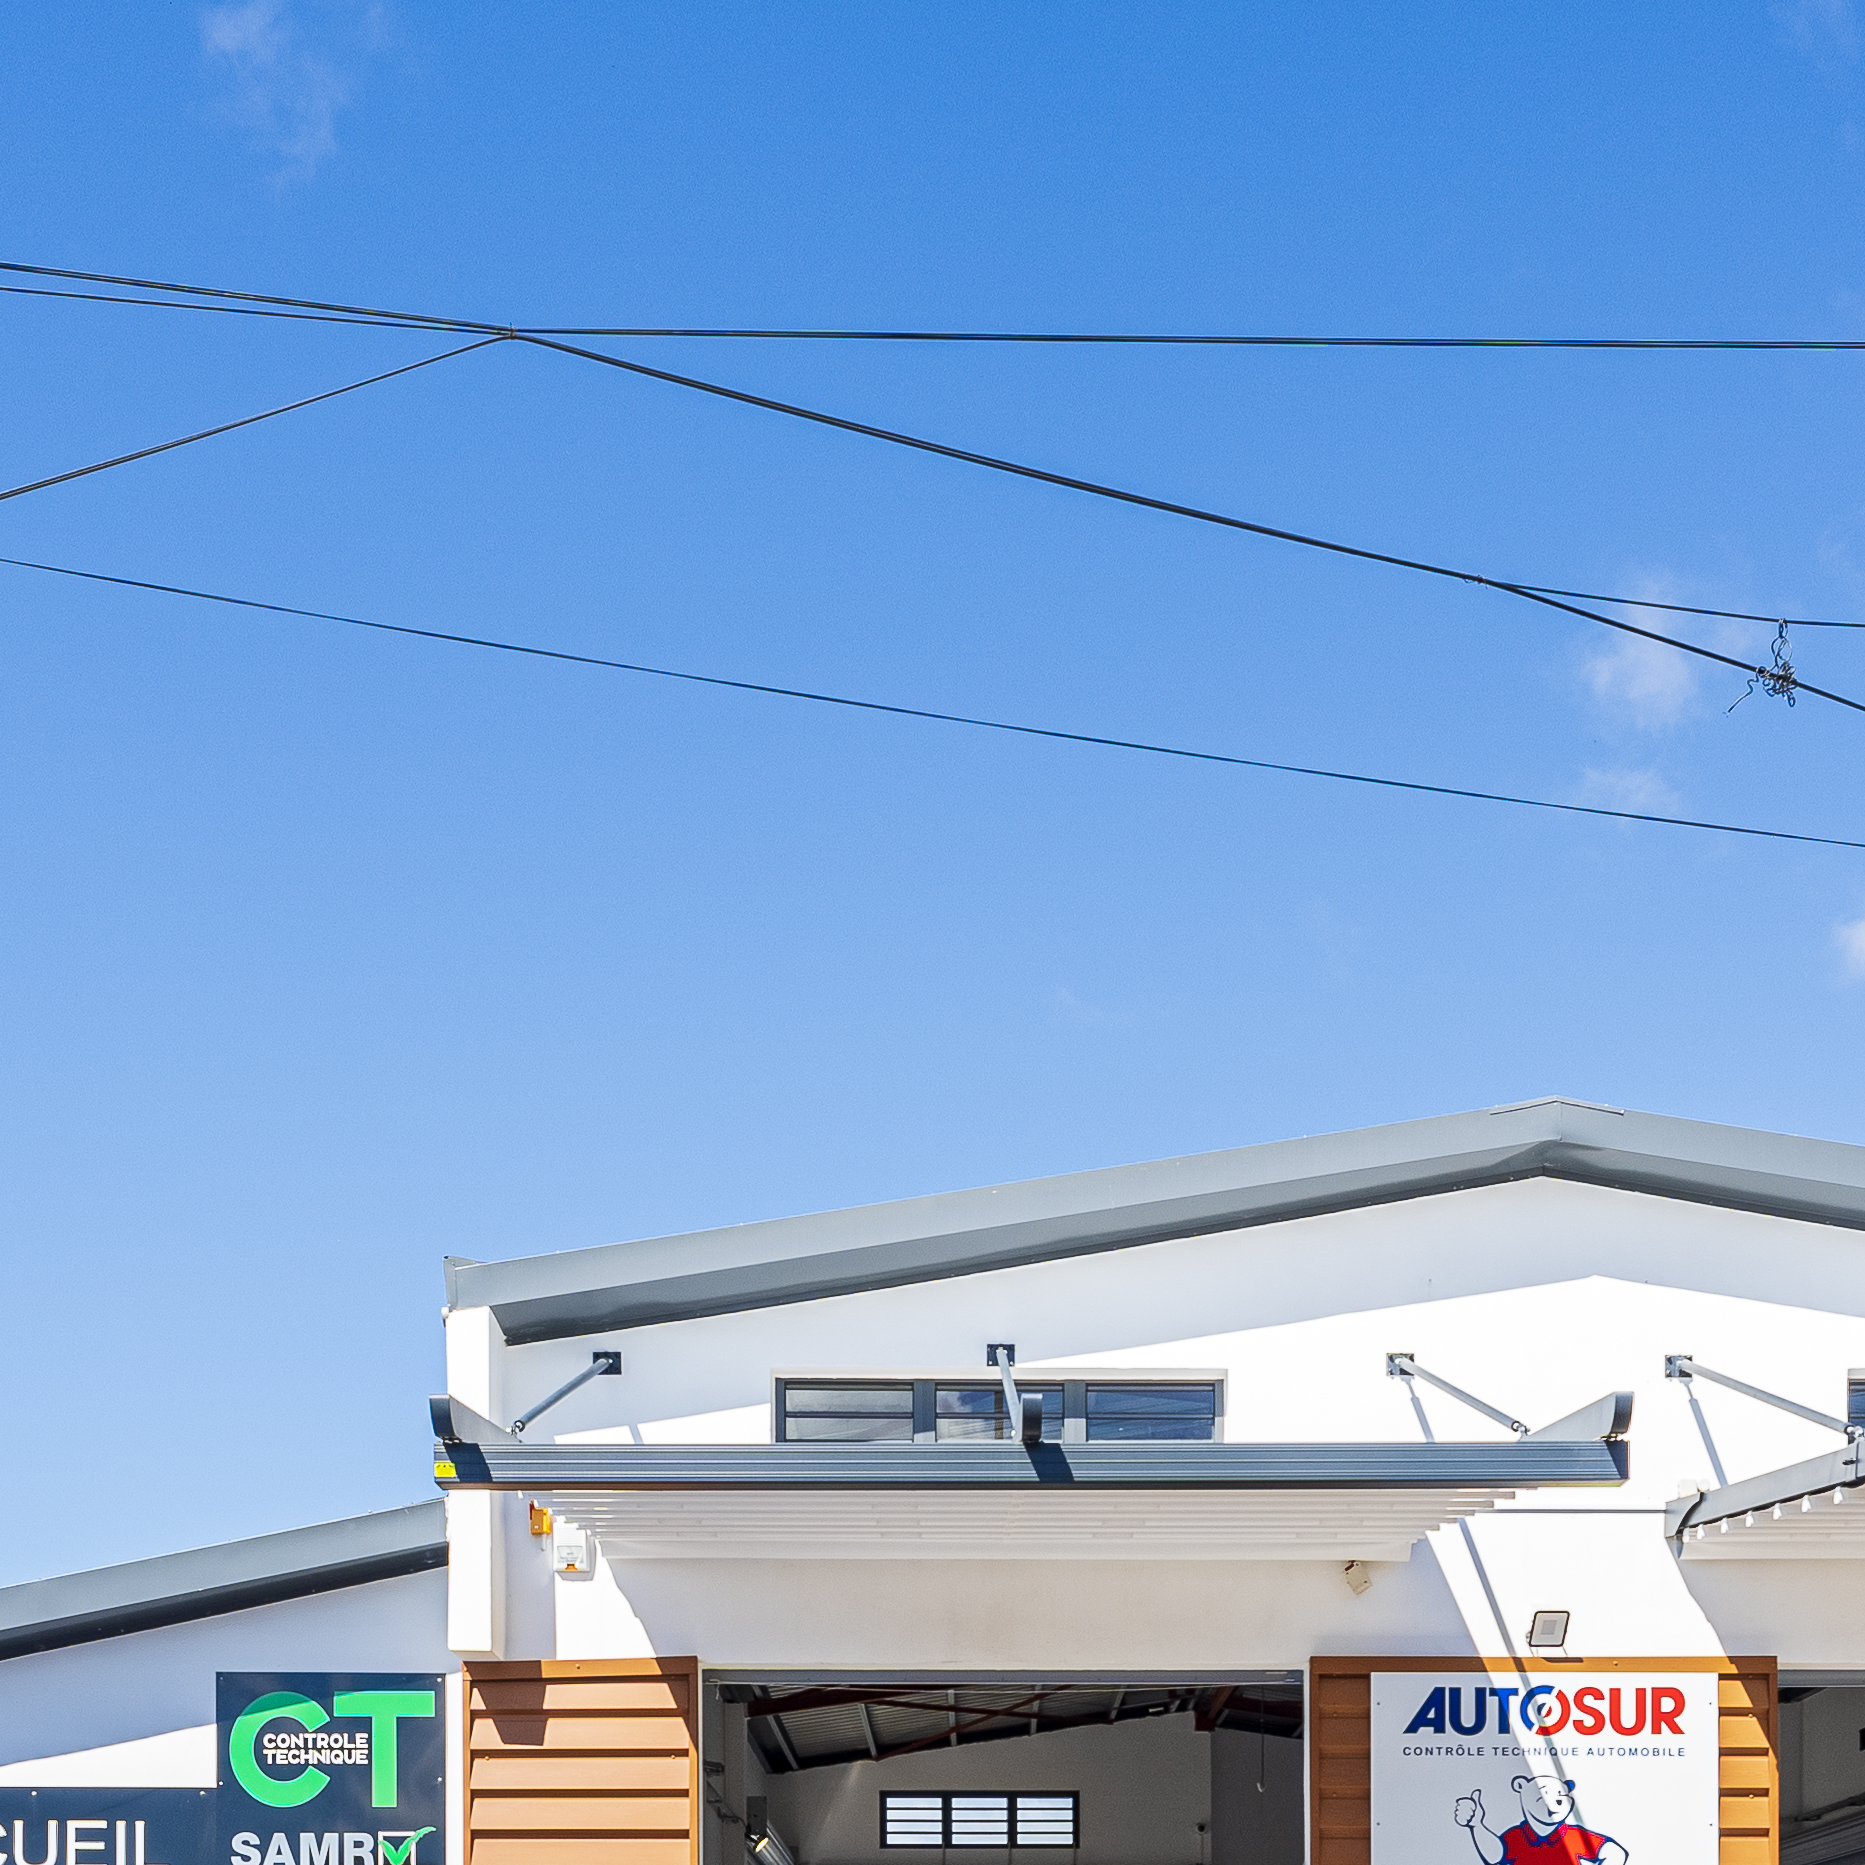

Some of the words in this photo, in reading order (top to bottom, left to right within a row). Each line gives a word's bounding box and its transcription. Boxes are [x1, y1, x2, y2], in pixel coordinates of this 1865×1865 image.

[1402, 1684, 1686, 1737] AUTOSUR
[229, 1690, 435, 1808] CT
[262, 1732, 369, 1749] CONTROLE
[262, 1749, 369, 1765] TECHNIQUE
[1402, 1743, 1485, 1757] CONTRÔLE
[1491, 1746, 1580, 1759] TECHNIQUE
[1586, 1747, 1686, 1758] AUTOMOBILE
